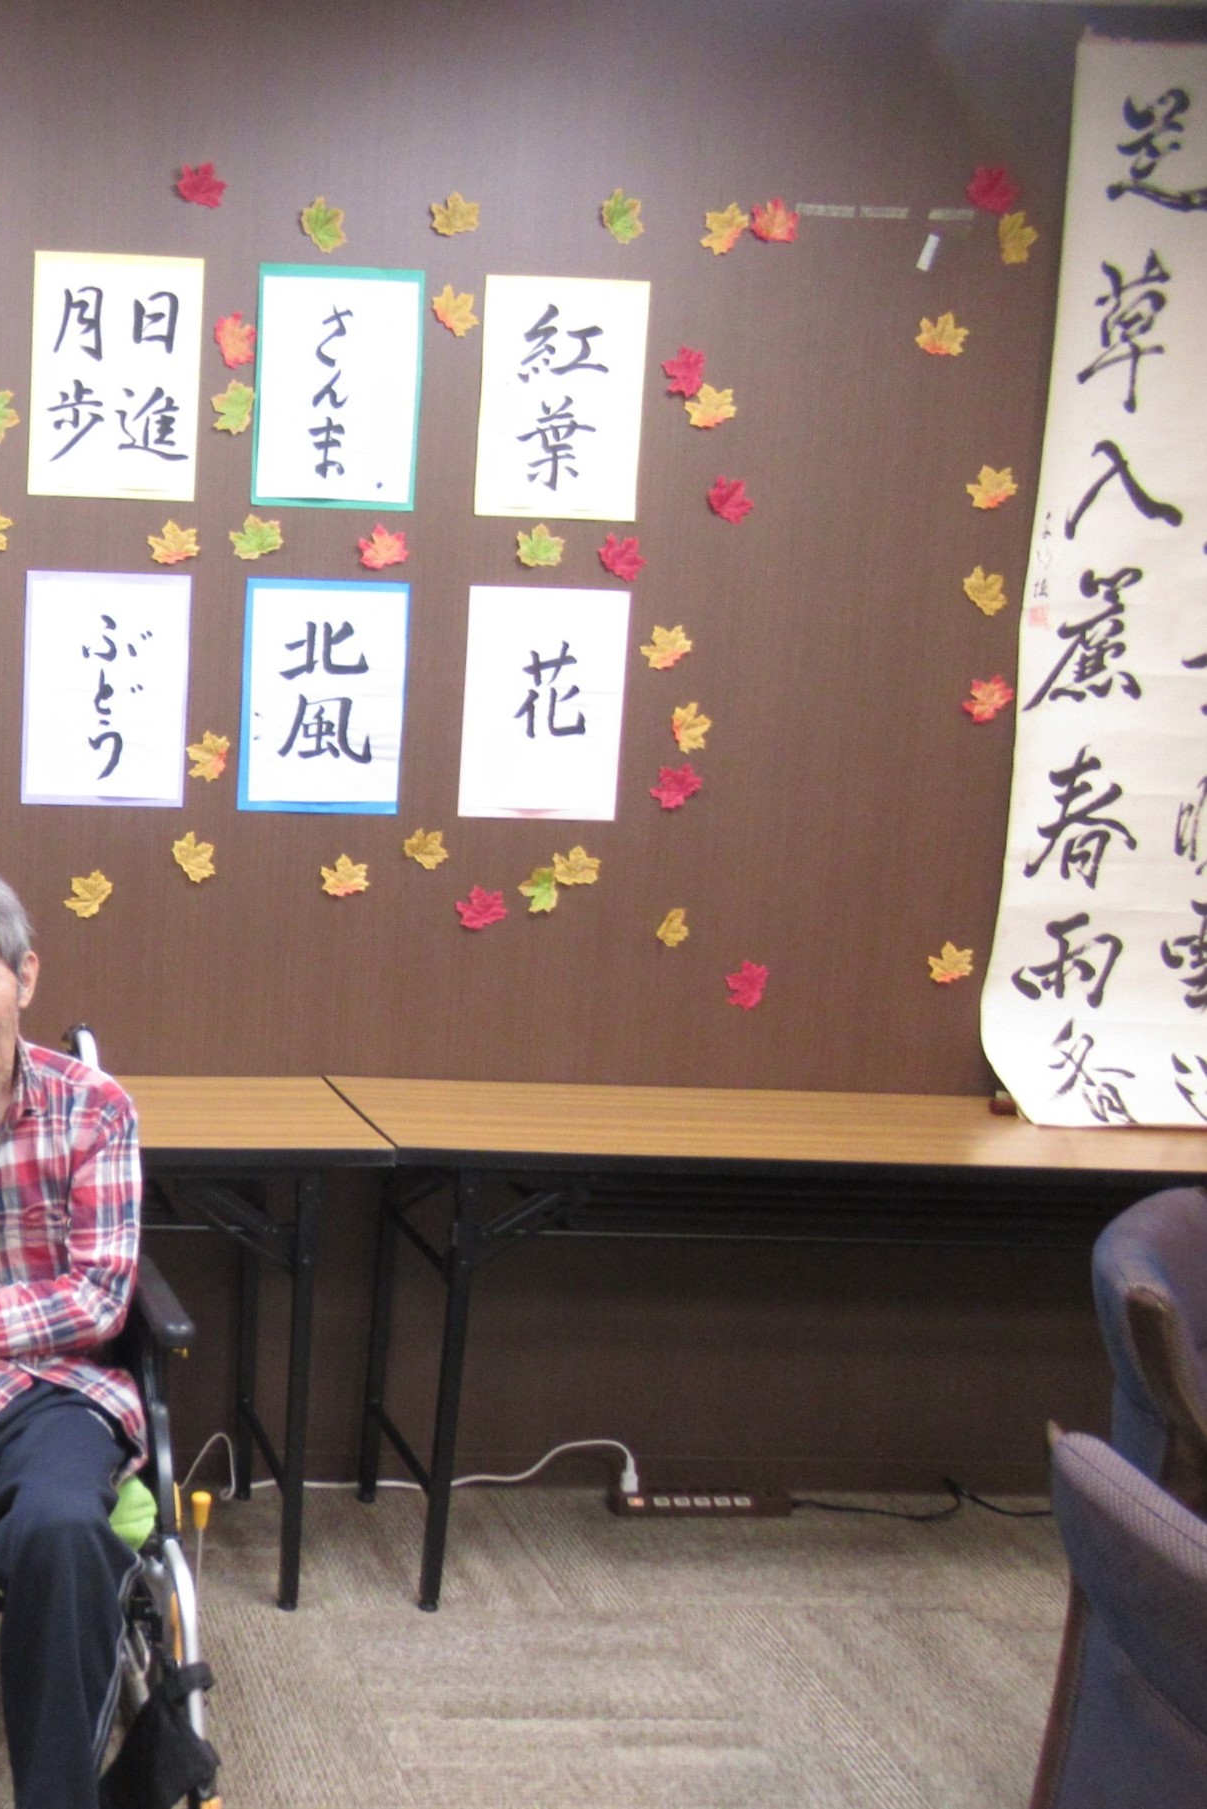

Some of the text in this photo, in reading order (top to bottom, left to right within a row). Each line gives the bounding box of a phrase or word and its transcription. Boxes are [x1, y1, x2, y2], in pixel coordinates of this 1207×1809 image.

[49, 287, 103, 459] 月歩
[117, 292, 187, 460] 日進
[308, 305, 354, 477] さんま
[519, 305, 608, 490] 紅葉
[83, 615, 152, 778] ぶどう
[279, 622, 372, 763] 北風
[514, 641, 585, 738] 花
